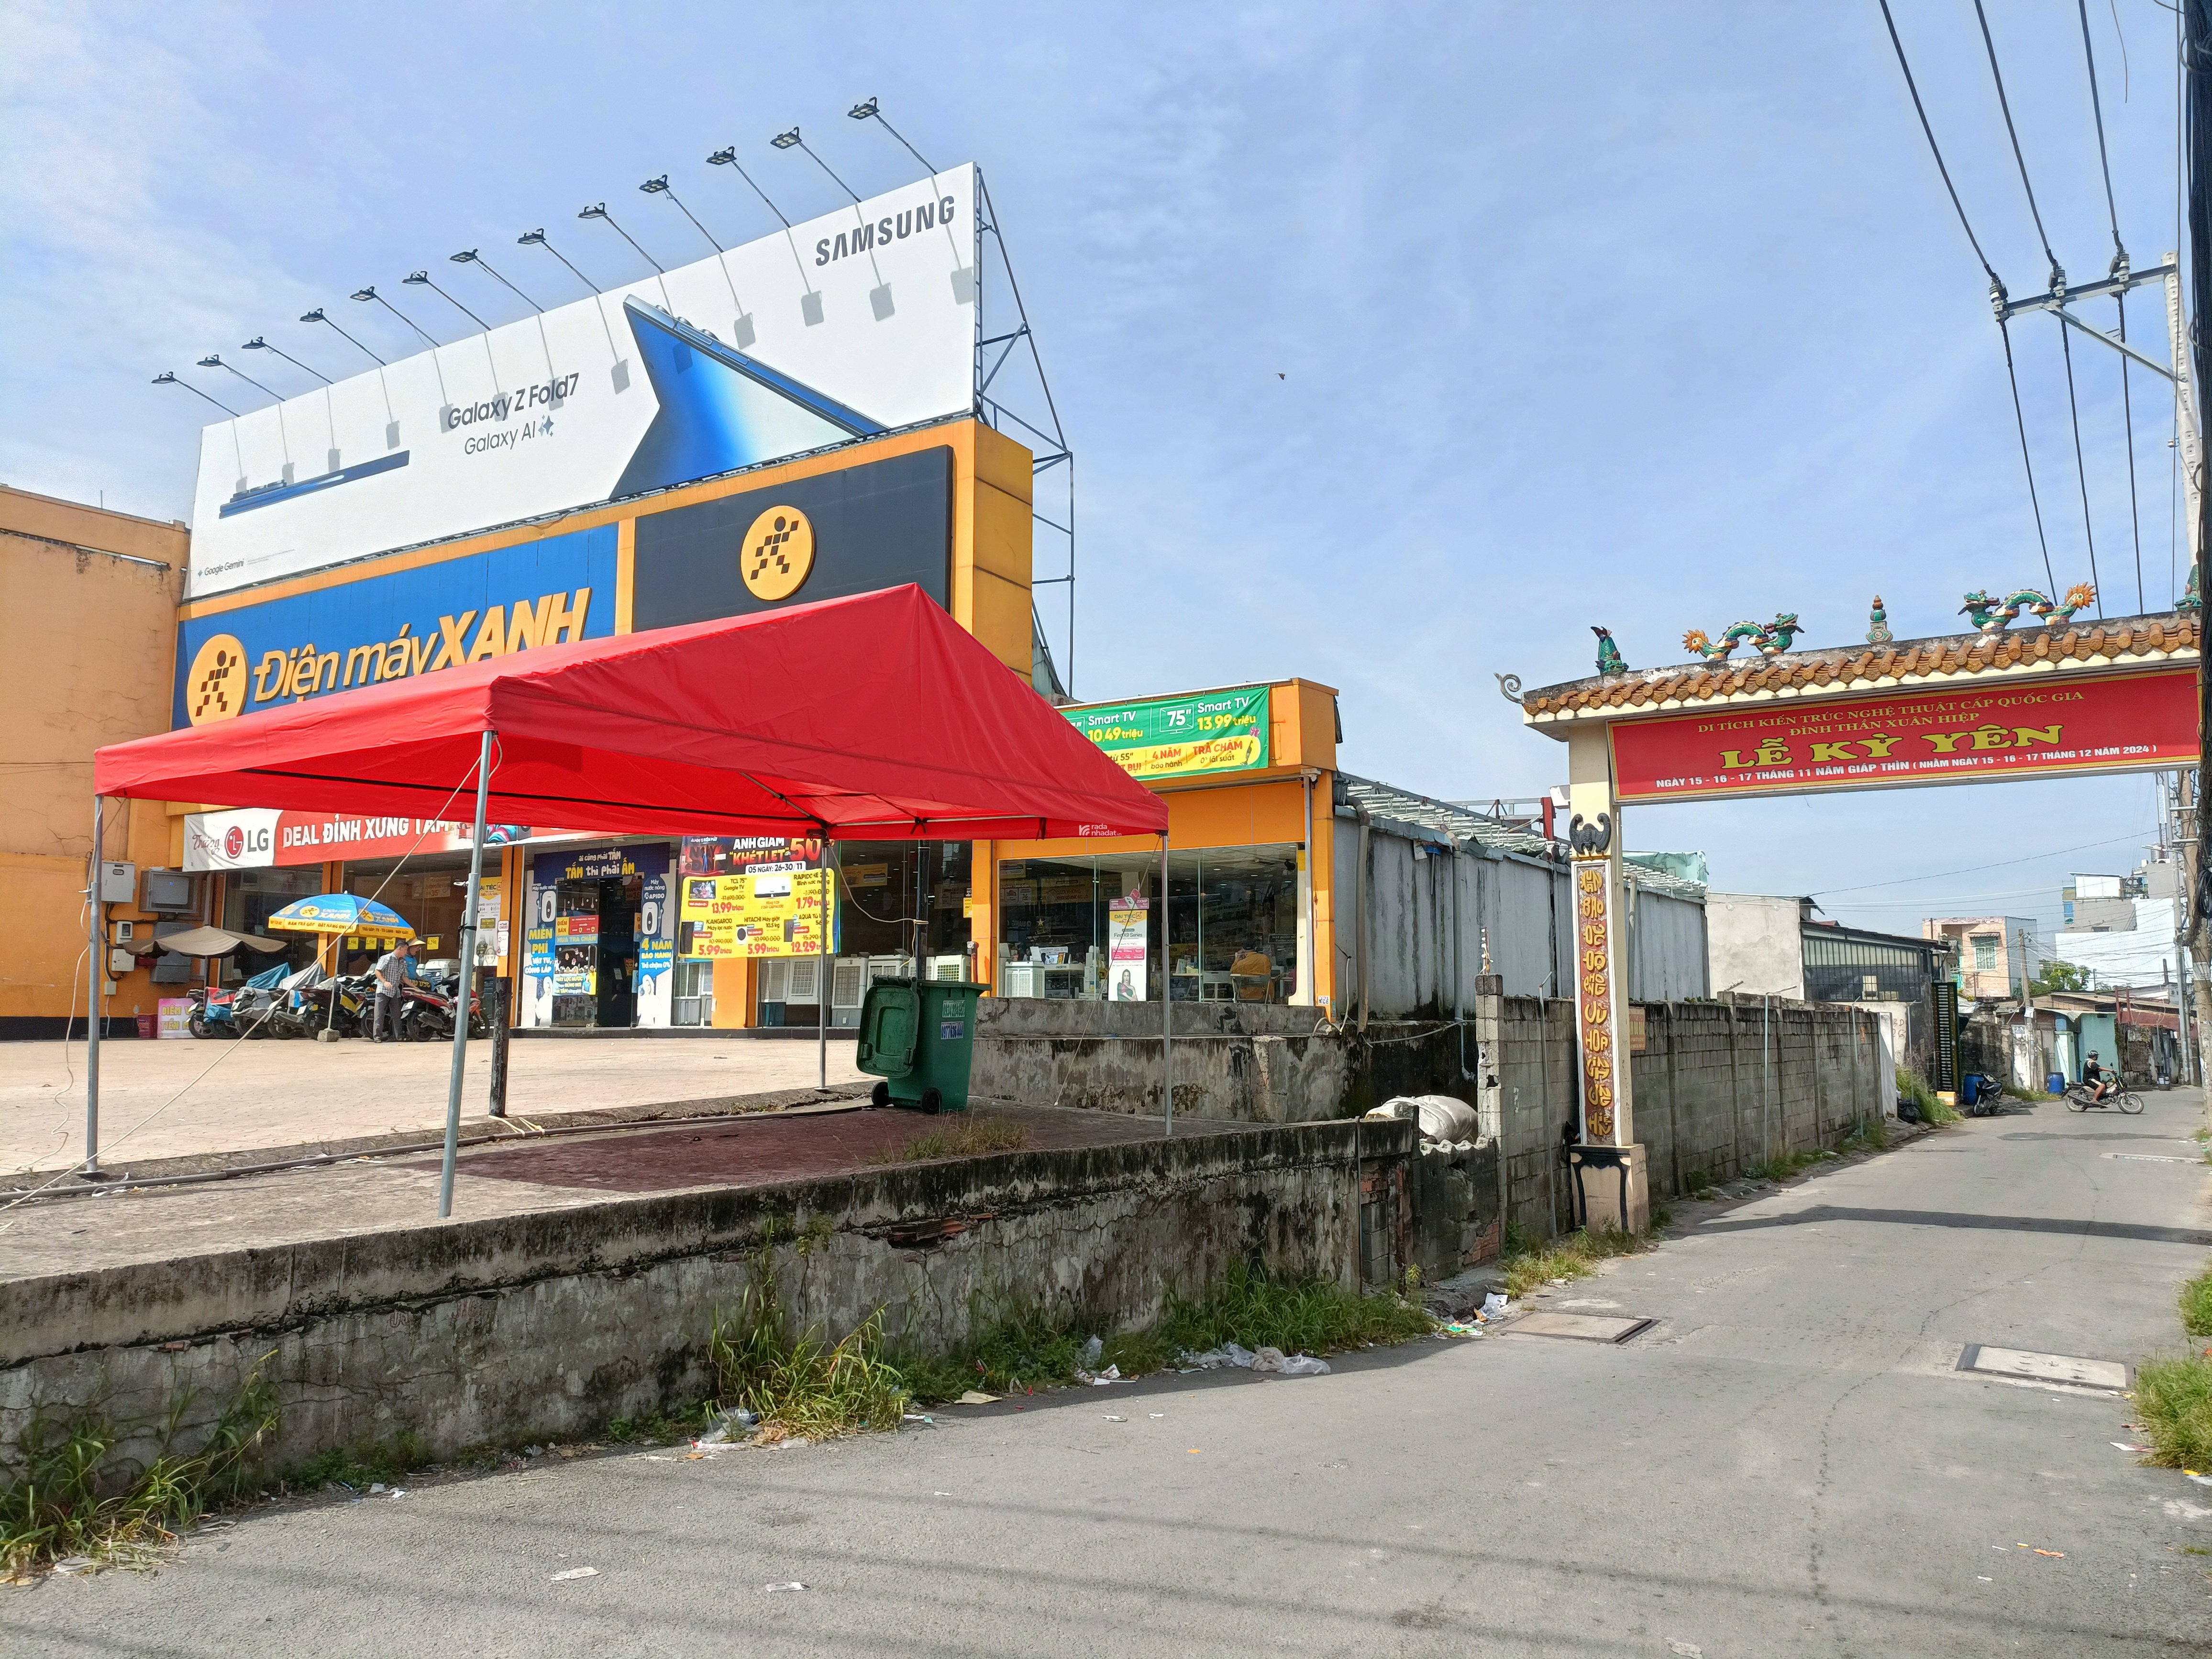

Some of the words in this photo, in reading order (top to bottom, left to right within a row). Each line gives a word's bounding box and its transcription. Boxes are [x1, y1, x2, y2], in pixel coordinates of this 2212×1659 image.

[816, 196, 954, 266] SAMSUNG
[448, 396, 512, 429] Galaxy
[515, 388, 526, 411] Z
[529, 372, 579, 408] Fold7
[465, 429, 518, 454] Galaxy
[521, 421, 536, 441] AI
[204, 564, 223, 575] Google
[224, 558, 244, 571] Gemini
[254, 643, 341, 702] Điện
[430, 587, 592, 671] XANH
[1197, 701, 1231, 713] Smart
[1234, 697, 1250, 709] TV
[1698, 724, 1714, 732] DI
[1717, 720, 1754, 730] TÍCH
[1758, 715, 1797, 727] KIẾN
[1801, 711, 1844, 723] TRÚC
[1847, 706, 1895, 718] NGHỆ
[1898, 701, 1957, 715] THUẬT
[1961, 697, 1993, 709] CẤP
[1998, 692, 2047, 707] QUỐC
[2051, 691, 2084, 702] GIA
[1088, 713, 1120, 726] Smart
[1122, 710, 1136, 722] TV
[1197, 714, 1232, 731] 13,99
[1233, 714, 1257, 727] triệu
[1790, 724, 1832, 736] ĐÌNH
[1835, 719, 1881, 732] THẦN
[1885, 716, 1933, 728] XUÂN
[1938, 712, 1980, 723] HIỆP
[1088, 727, 1121, 742] 10,49
[1122, 729, 1143, 741] triệu
[1153, 752, 1158, 760] 4
[1160, 747, 1181, 759] NĂM
[1193, 742, 1211, 755] TRẢ
[1214, 740, 1242, 753] CHẬM
[1718, 737, 1793, 769] LỄ
[1920, 724, 2065, 753] YÊN
[1656, 777, 1685, 788] NGÀY
[1689, 777, 1703, 785] 15
[1714, 775, 1727, 784] 16
[1738, 773, 1752, 781] 17
[1755, 770, 1794, 780] THÁNG
[1797, 769, 1811, 777] 11
[1815, 765, 1845, 776] NĂM
[1848, 764, 1877, 774] GIÁP
[1880, 761, 1909, 771] THÌN
[1952, 756, 1980, 766] NGÀY
[1981, 756, 1994, 764] 15
[2003, 754, 2015, 763] 16
[2025, 753, 2038, 762] 17
[2041, 750, 2076, 760] THÁNG
[2079, 749, 2092, 757] 12
[2094, 746, 2120, 756] NĂM
[2123, 745, 2149, 754] 2024
[247, 829, 268, 852] LG
[283, 824, 320, 848] DEAL
[322, 814, 361, 843] ĐỈNH
[733, 839, 756, 850] ANH
[532, 941, 548, 953] PHÍ
[641, 938, 649, 950] 4
[652, 940, 672, 950] NĂM
